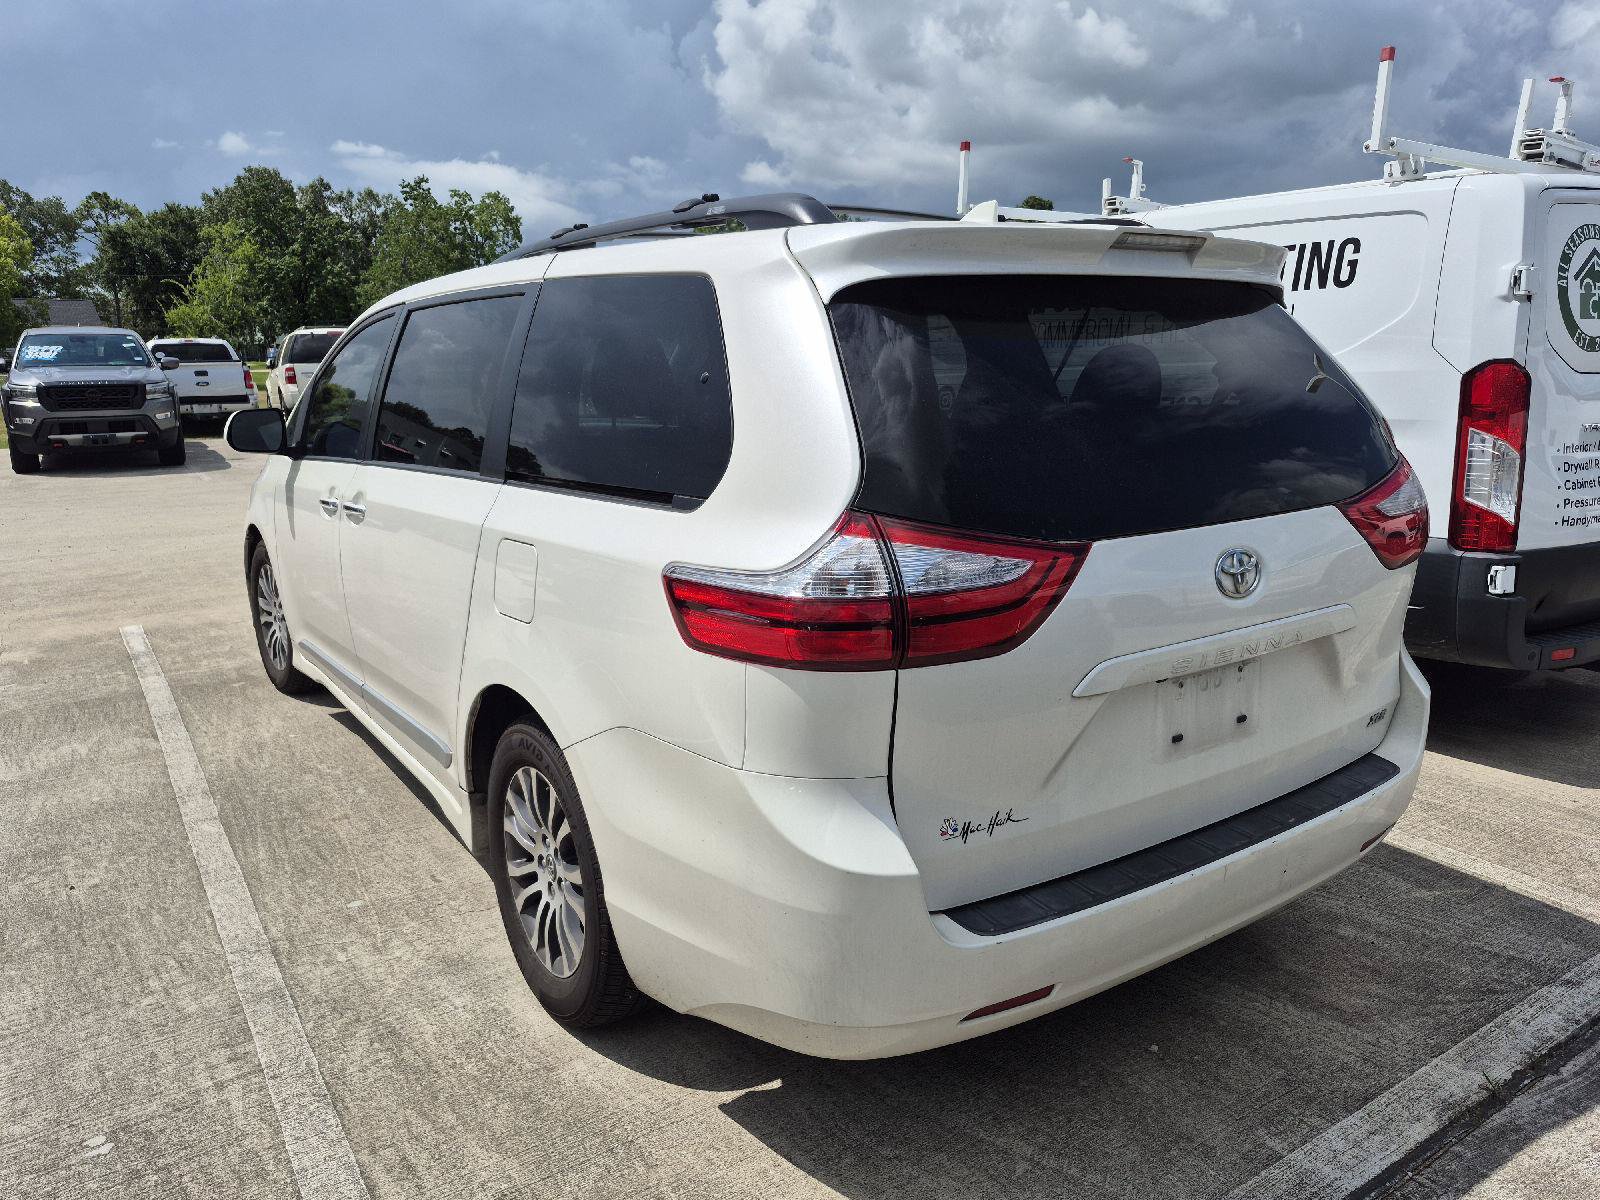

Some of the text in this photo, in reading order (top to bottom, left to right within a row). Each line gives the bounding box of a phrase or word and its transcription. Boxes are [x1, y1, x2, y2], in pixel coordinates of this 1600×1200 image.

[1281, 237, 1361, 291] ING
[1558, 224, 1600, 287] ALL SEASONS
[1563, 441, 1592, 454] Interior
[1563, 459, 1593, 474] Drywall
[1564, 478, 1597, 490] Cabinet
[1170, 631, 1303, 674] SIENNA
[518, 737, 544, 762] AVID
[987, 808, 1029, 837] Haik
